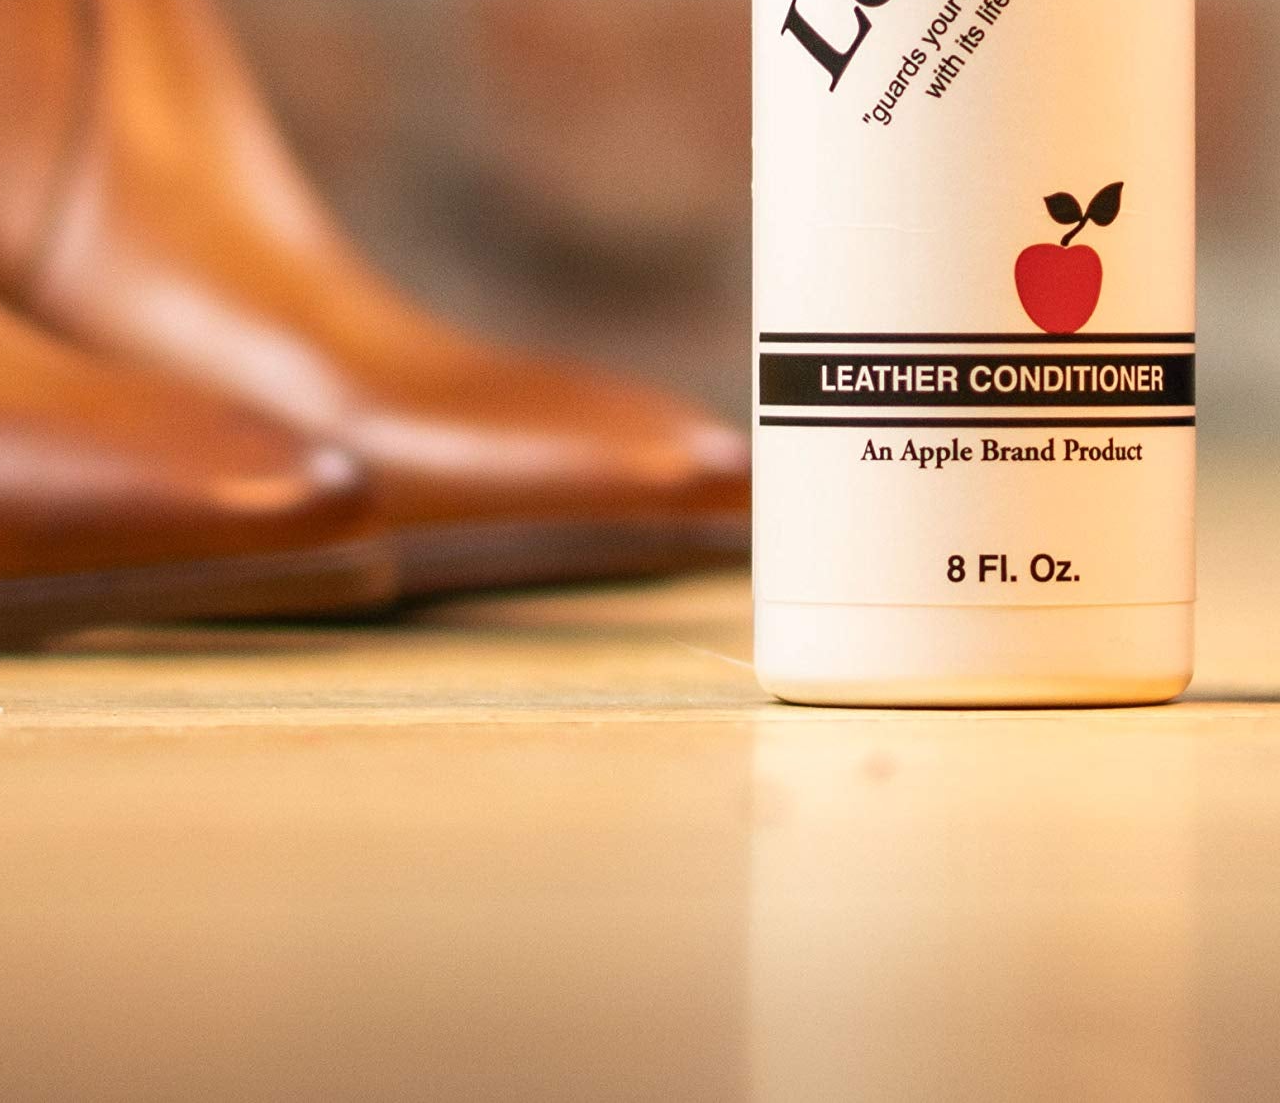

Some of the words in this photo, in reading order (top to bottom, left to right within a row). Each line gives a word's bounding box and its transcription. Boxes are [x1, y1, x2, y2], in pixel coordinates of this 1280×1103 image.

[924, 54, 966, 99] with
[954, 24, 986, 55] its
[861, 48, 928, 127] "guards
[821, 365, 959, 392] LEATHER
[969, 364, 1164, 392] CONDITIONER
[860, 439, 893, 461] An
[900, 438, 973, 469] Apple
[981, 437, 1056, 462] Brand
[1063, 437, 1143, 462] Product
[946, 554, 966, 583] 8
[978, 554, 1018, 583] Fl.
[1029, 553, 1080, 583] Oz.
